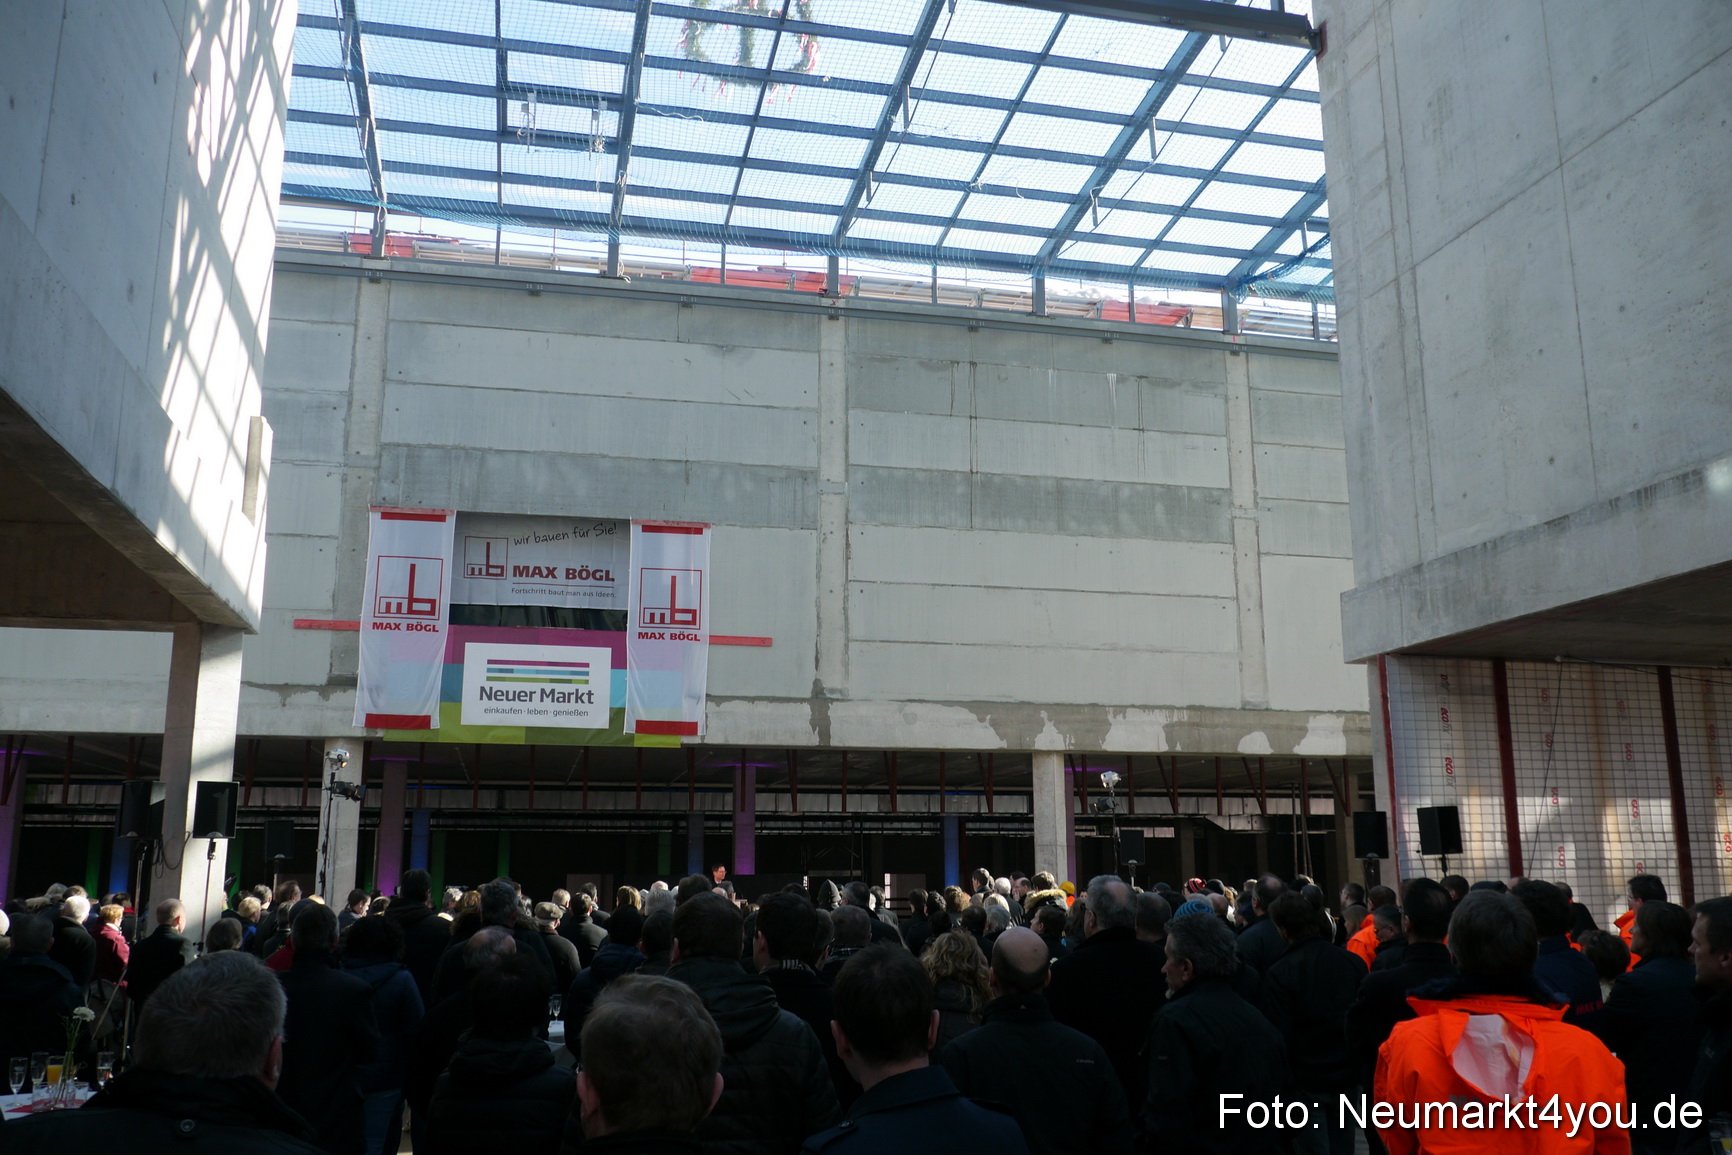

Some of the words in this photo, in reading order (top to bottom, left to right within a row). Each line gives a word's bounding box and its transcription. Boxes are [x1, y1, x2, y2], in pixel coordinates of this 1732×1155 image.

[514, 535, 530, 546] wir
[534, 531, 569, 543] bauen
[572, 526, 590, 538] für
[593, 523, 618, 537] Sie!
[513, 565, 558, 579] MAX
[565, 565, 615, 582] BÖGL
[372, 622, 402, 631] MAX
[406, 622, 439, 632] BÖGL
[638, 632, 665, 640] MAX
[670, 631, 700, 641] BÖGL
[480, 686, 536, 703] Neuer
[540, 688, 594, 704] Markt
